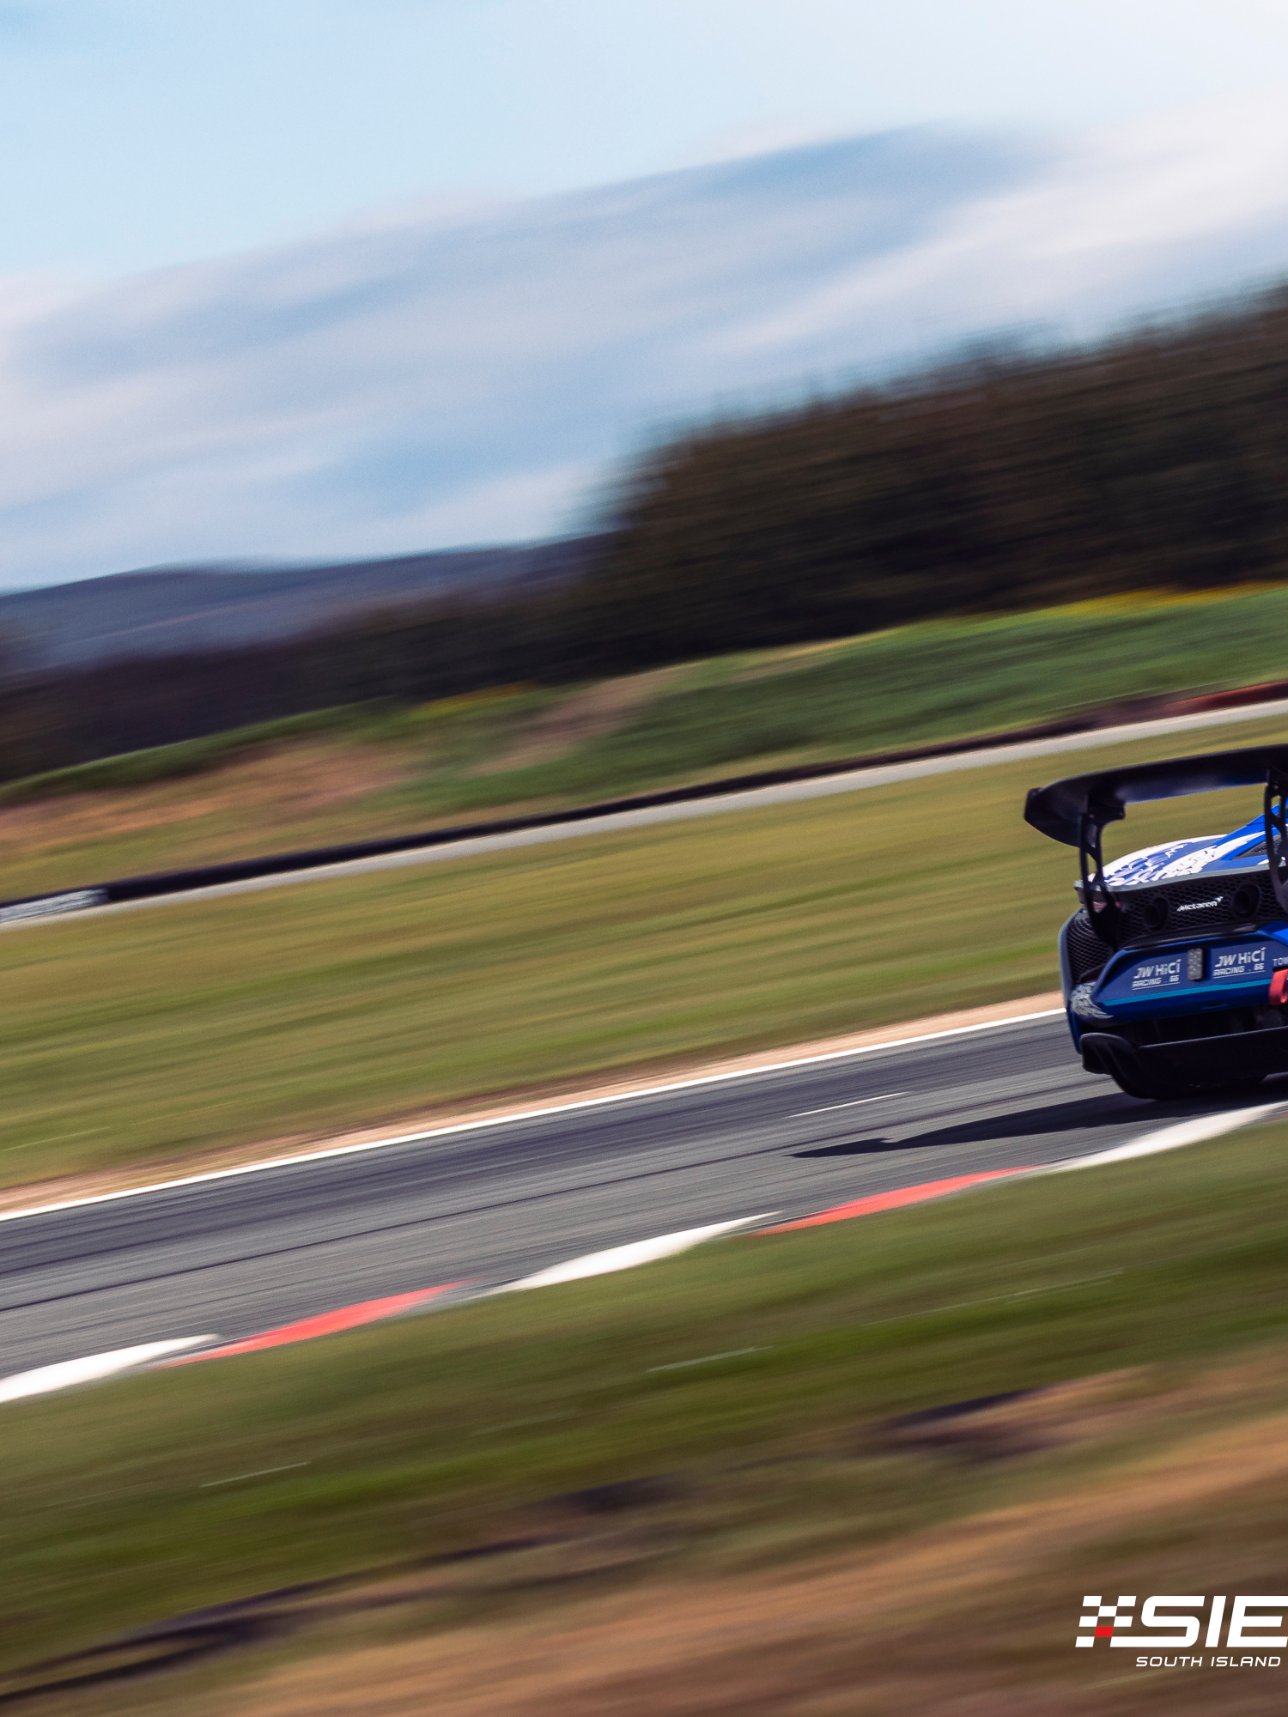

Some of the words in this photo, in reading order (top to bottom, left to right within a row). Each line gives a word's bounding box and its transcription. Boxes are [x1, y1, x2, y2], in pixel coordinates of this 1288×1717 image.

[1213, 953, 1238, 967] JW
[1272, 957, 1288, 967] TOW
[1132, 965, 1155, 980] JW
[1213, 965, 1245, 977] RACING
[1131, 977, 1162, 989] RACING
